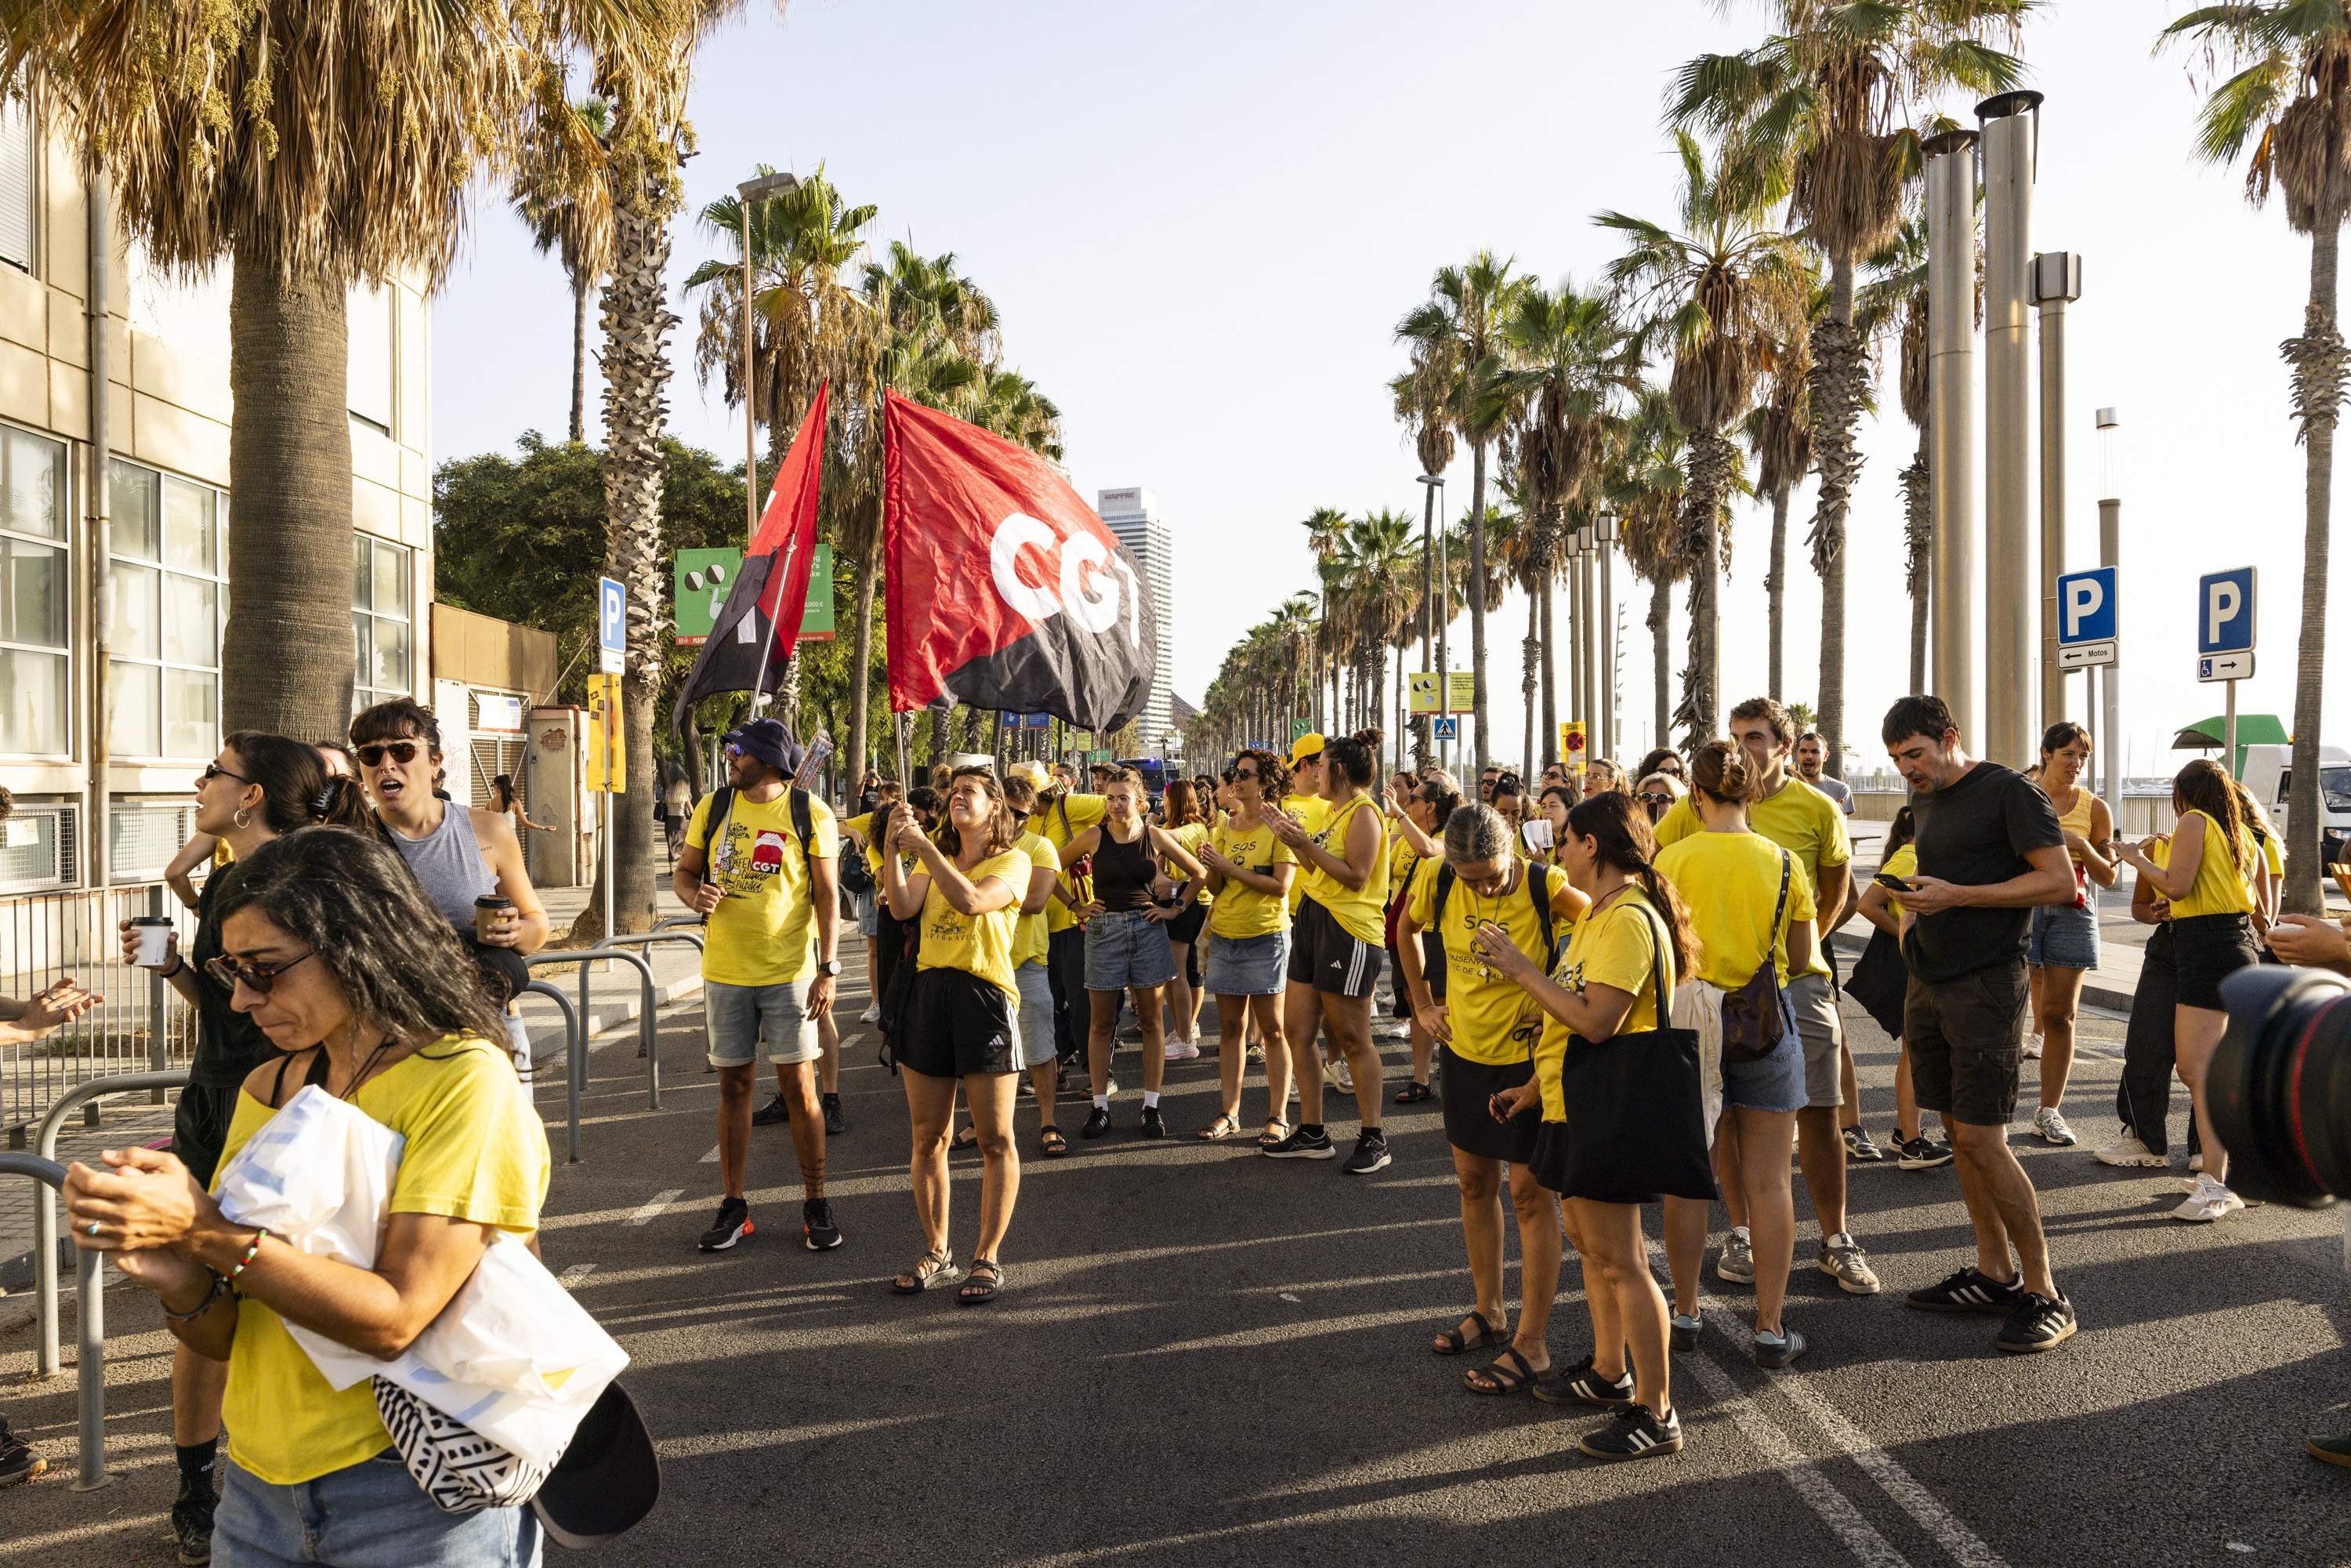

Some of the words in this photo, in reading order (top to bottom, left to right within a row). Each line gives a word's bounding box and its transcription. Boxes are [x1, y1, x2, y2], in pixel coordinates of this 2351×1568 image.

[1103, 491, 1136, 500] MAPFRE
[991, 512, 1139, 650] CGT
[606, 588, 621, 640] P
[2067, 578, 2103, 636] P
[2208, 580, 2241, 644] P
[2088, 648, 2108, 657] Motos
[1230, 841, 1257, 853] SOS
[752, 860, 780, 874] CGT
[1462, 966, 1474, 976] DE
